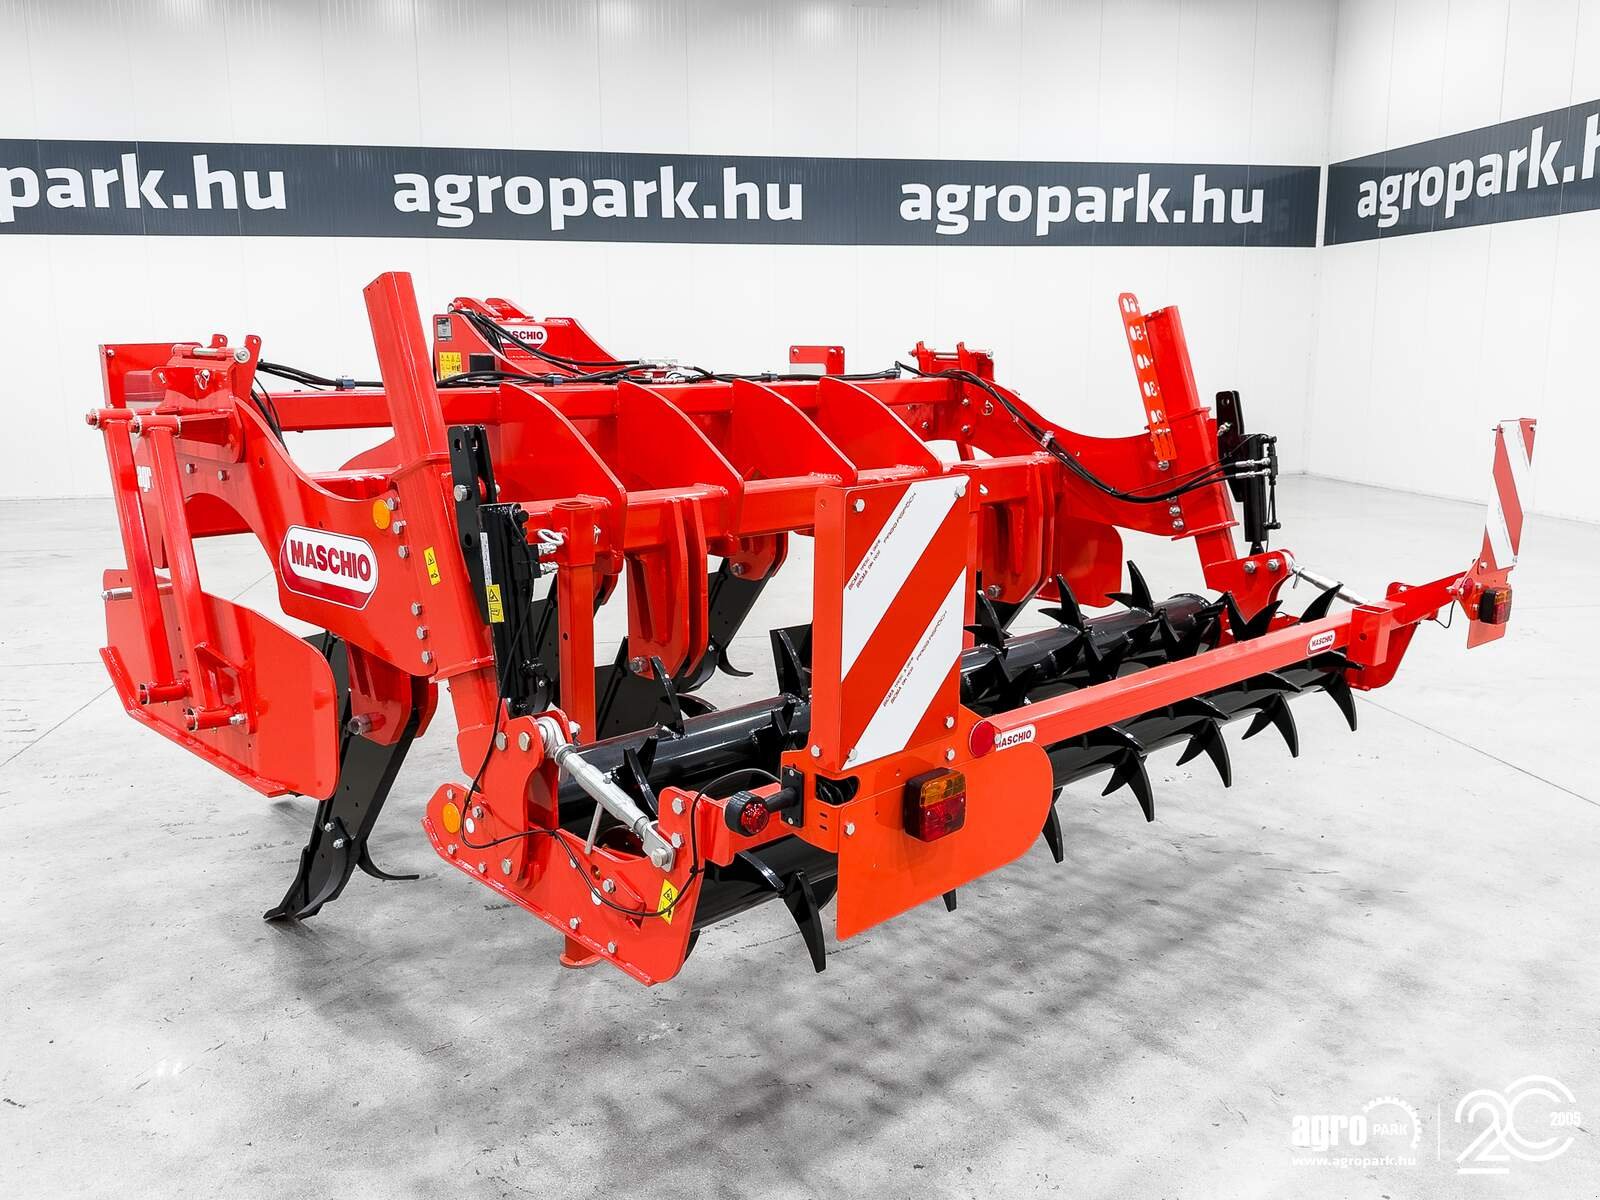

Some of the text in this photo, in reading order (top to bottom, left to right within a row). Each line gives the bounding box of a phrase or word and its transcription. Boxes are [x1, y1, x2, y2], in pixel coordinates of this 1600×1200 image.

[0, 153, 286, 223] park.hu
[393, 166, 803, 230] agropark.hu
[900, 173, 1264, 236] agropark.hu
[290, 540, 372, 582] MASCHIO
